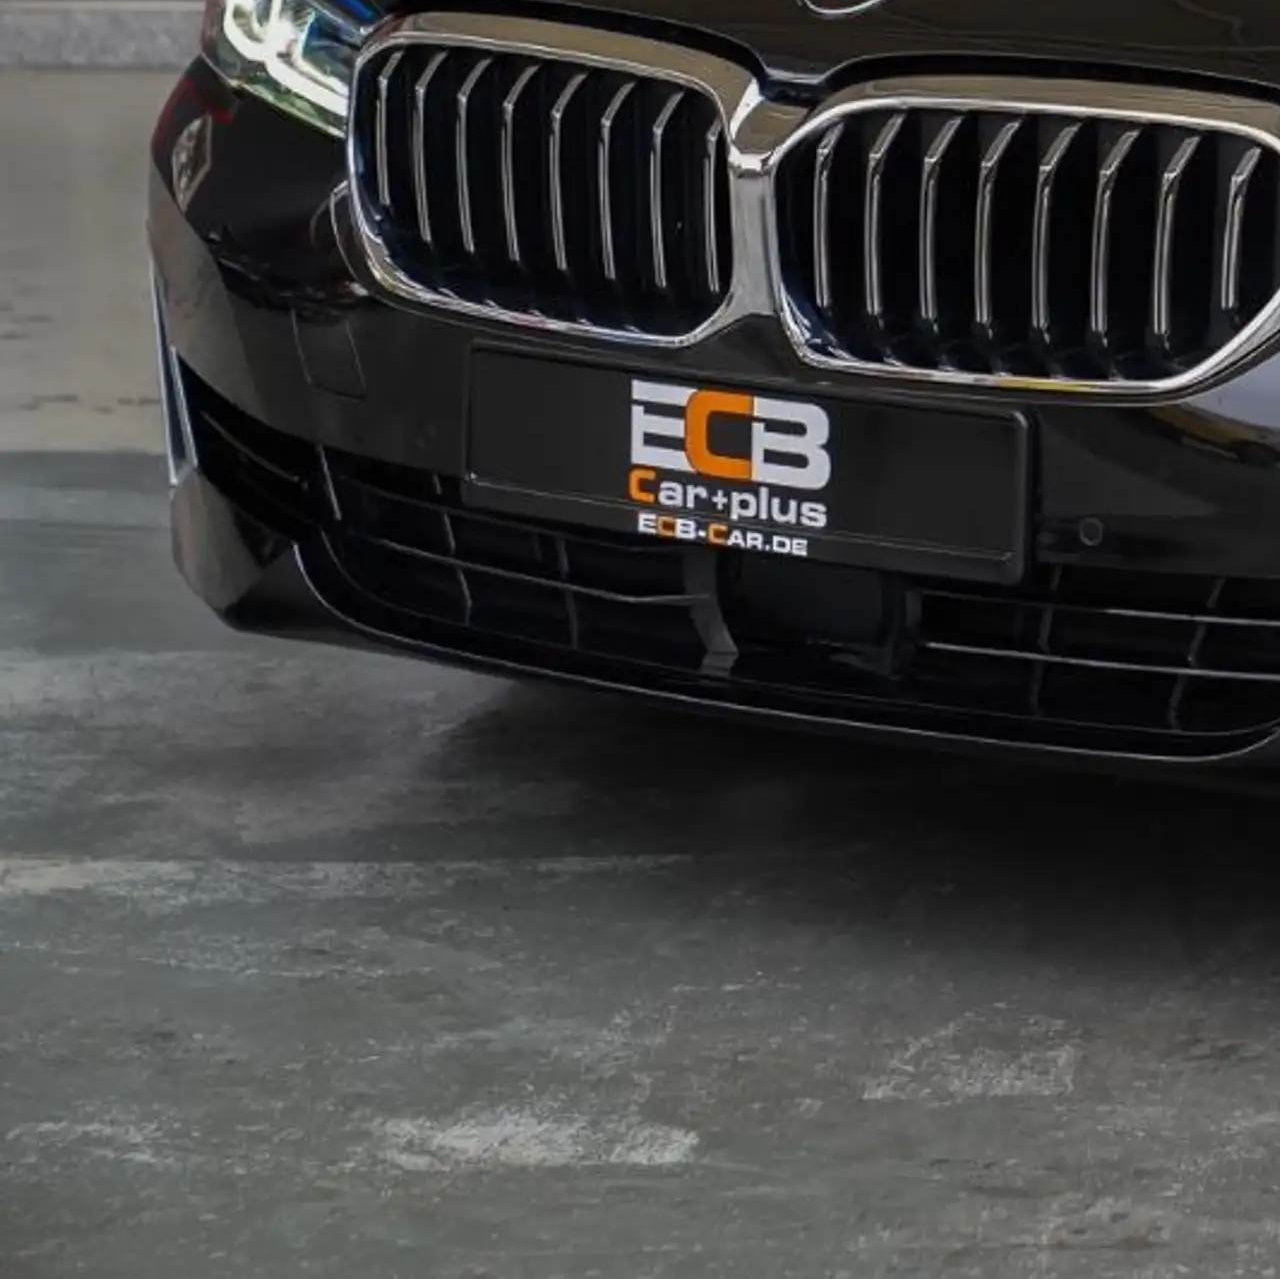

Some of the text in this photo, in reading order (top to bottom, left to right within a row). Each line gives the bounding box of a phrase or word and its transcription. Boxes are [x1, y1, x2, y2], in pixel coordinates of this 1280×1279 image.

[631, 379, 832, 491] ECB
[628, 466, 828, 528] Car+plus
[637, 513, 809, 557] ECB-CAR.DE
